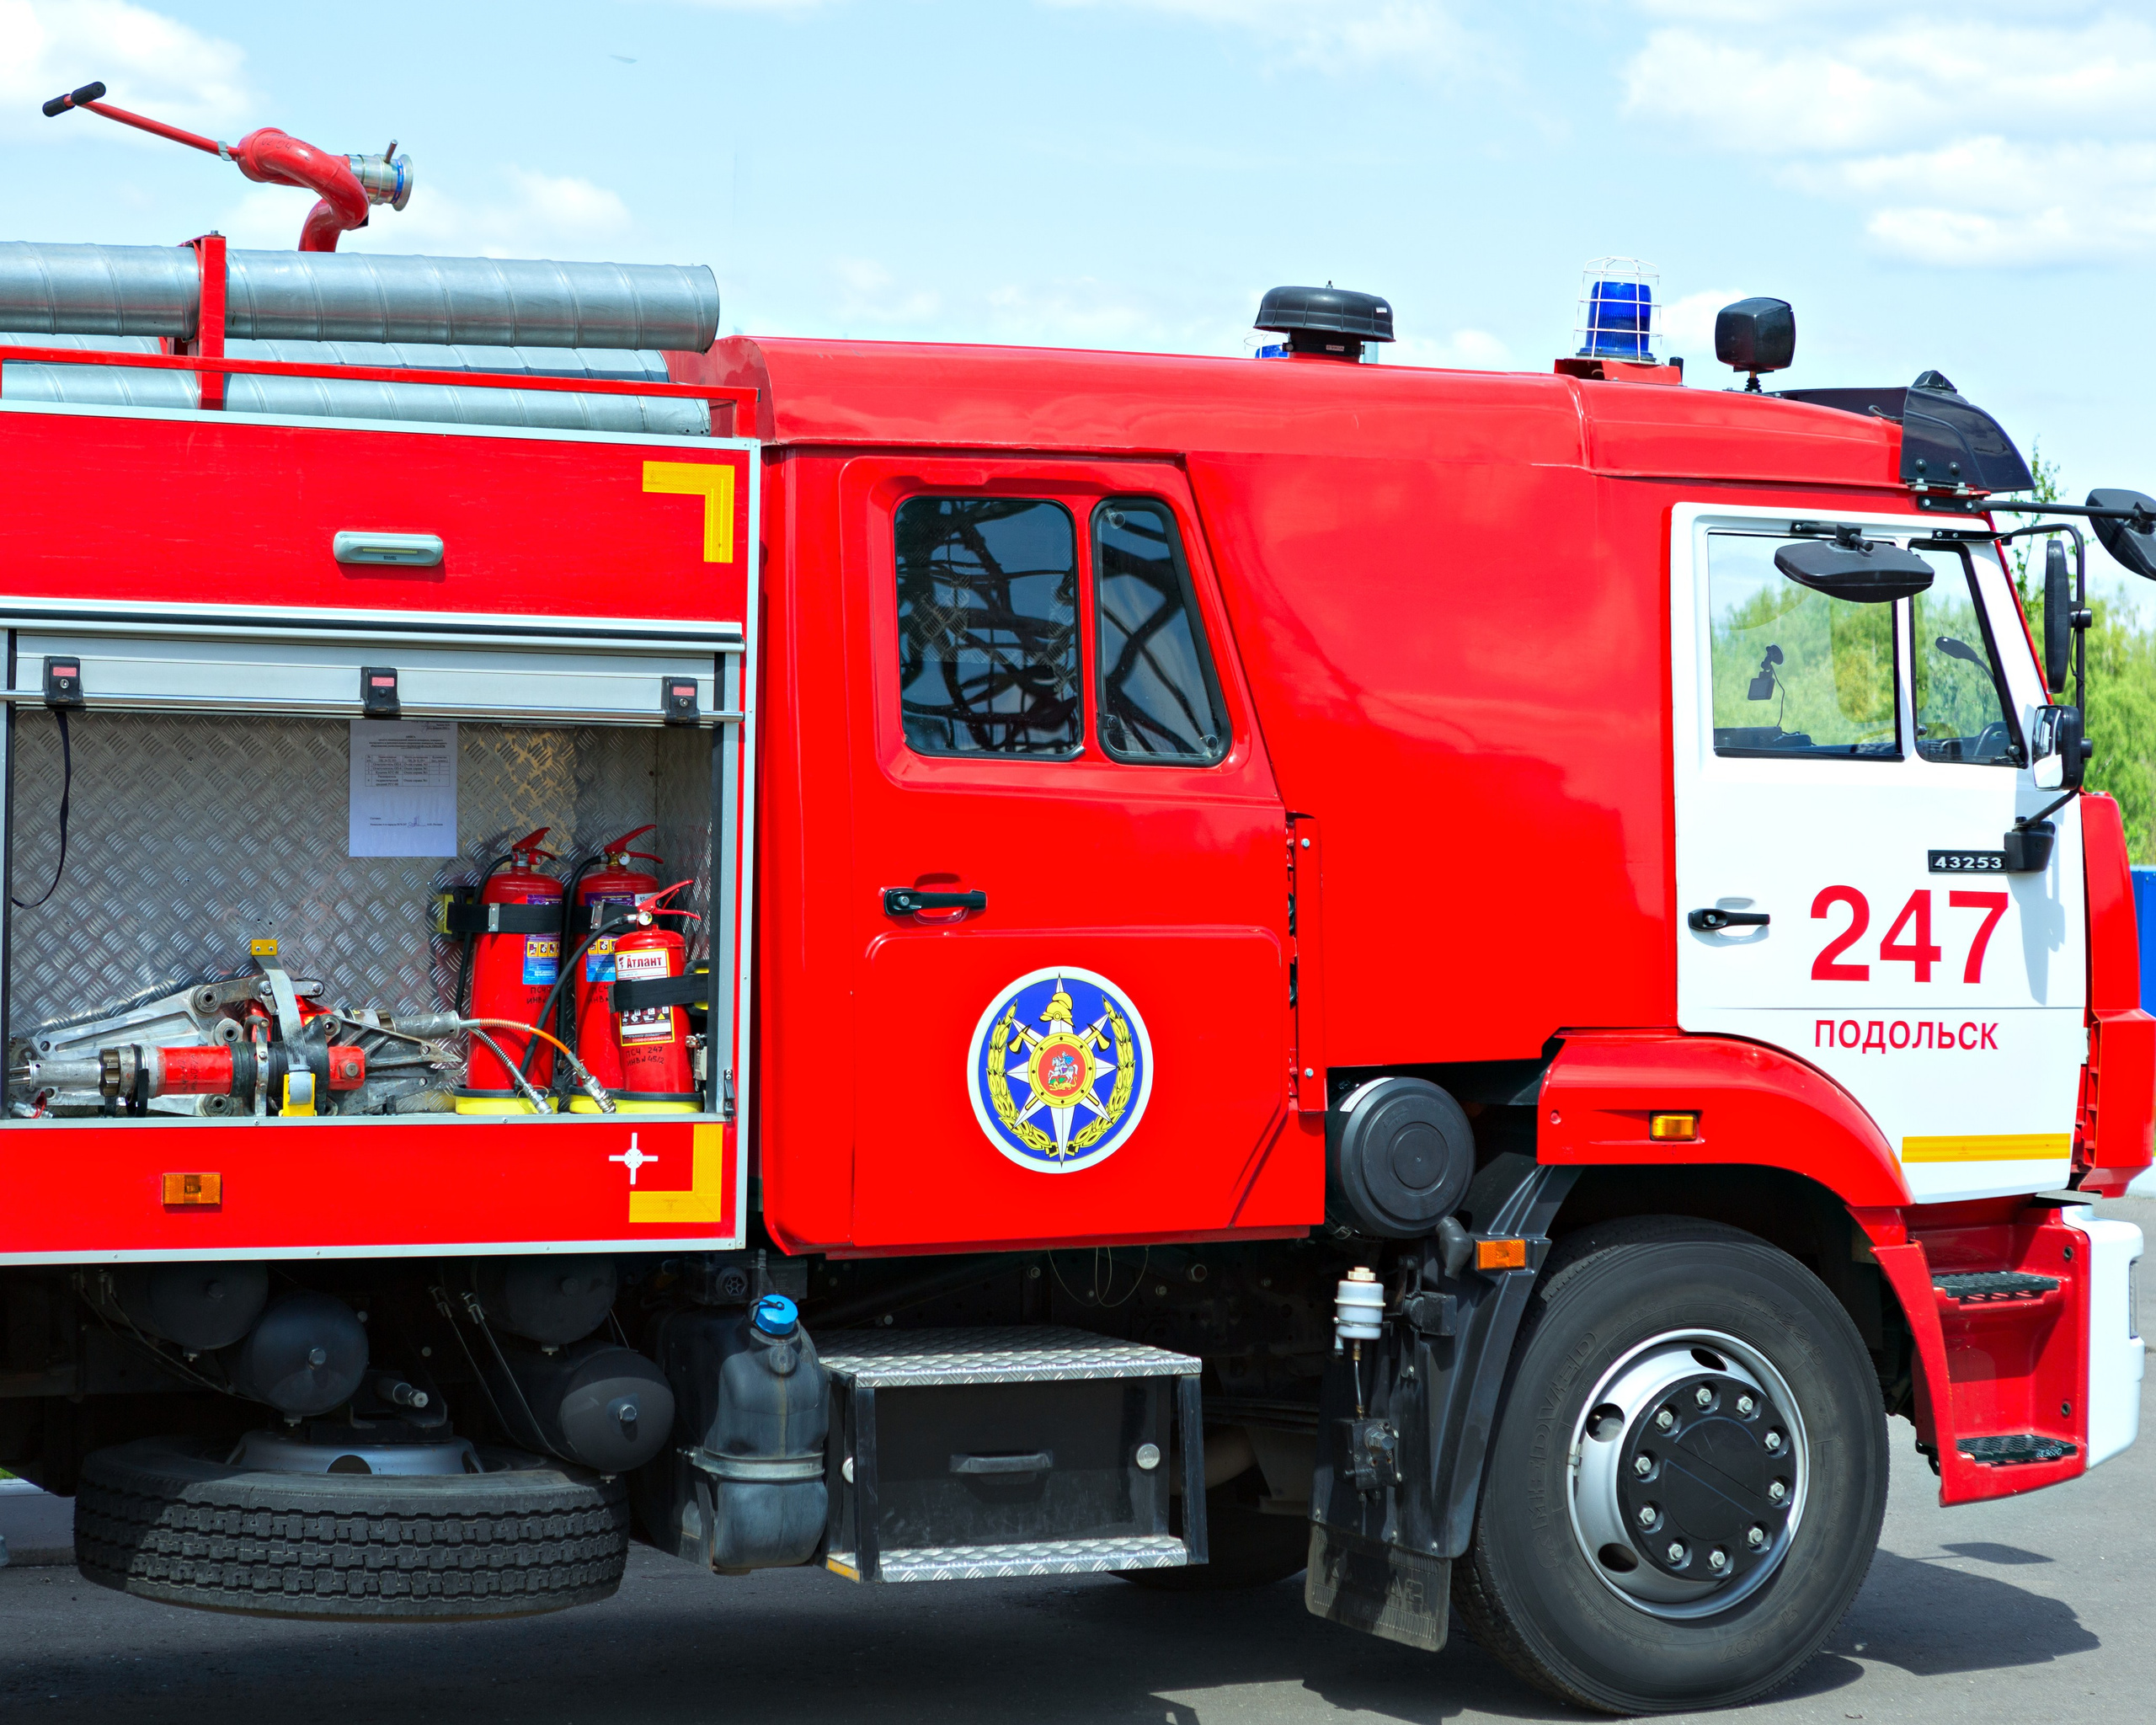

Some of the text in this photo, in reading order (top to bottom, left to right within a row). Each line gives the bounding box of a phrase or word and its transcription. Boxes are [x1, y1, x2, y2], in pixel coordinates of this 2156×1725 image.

[1934, 857, 2003, 869] 43253
[1811, 885, 2009, 984] 247
[627, 957, 662, 969] Атлант
[1815, 1020, 1999, 1055] ПОДОЛЬСК
[626, 1048, 641, 1058] ПСЧ
